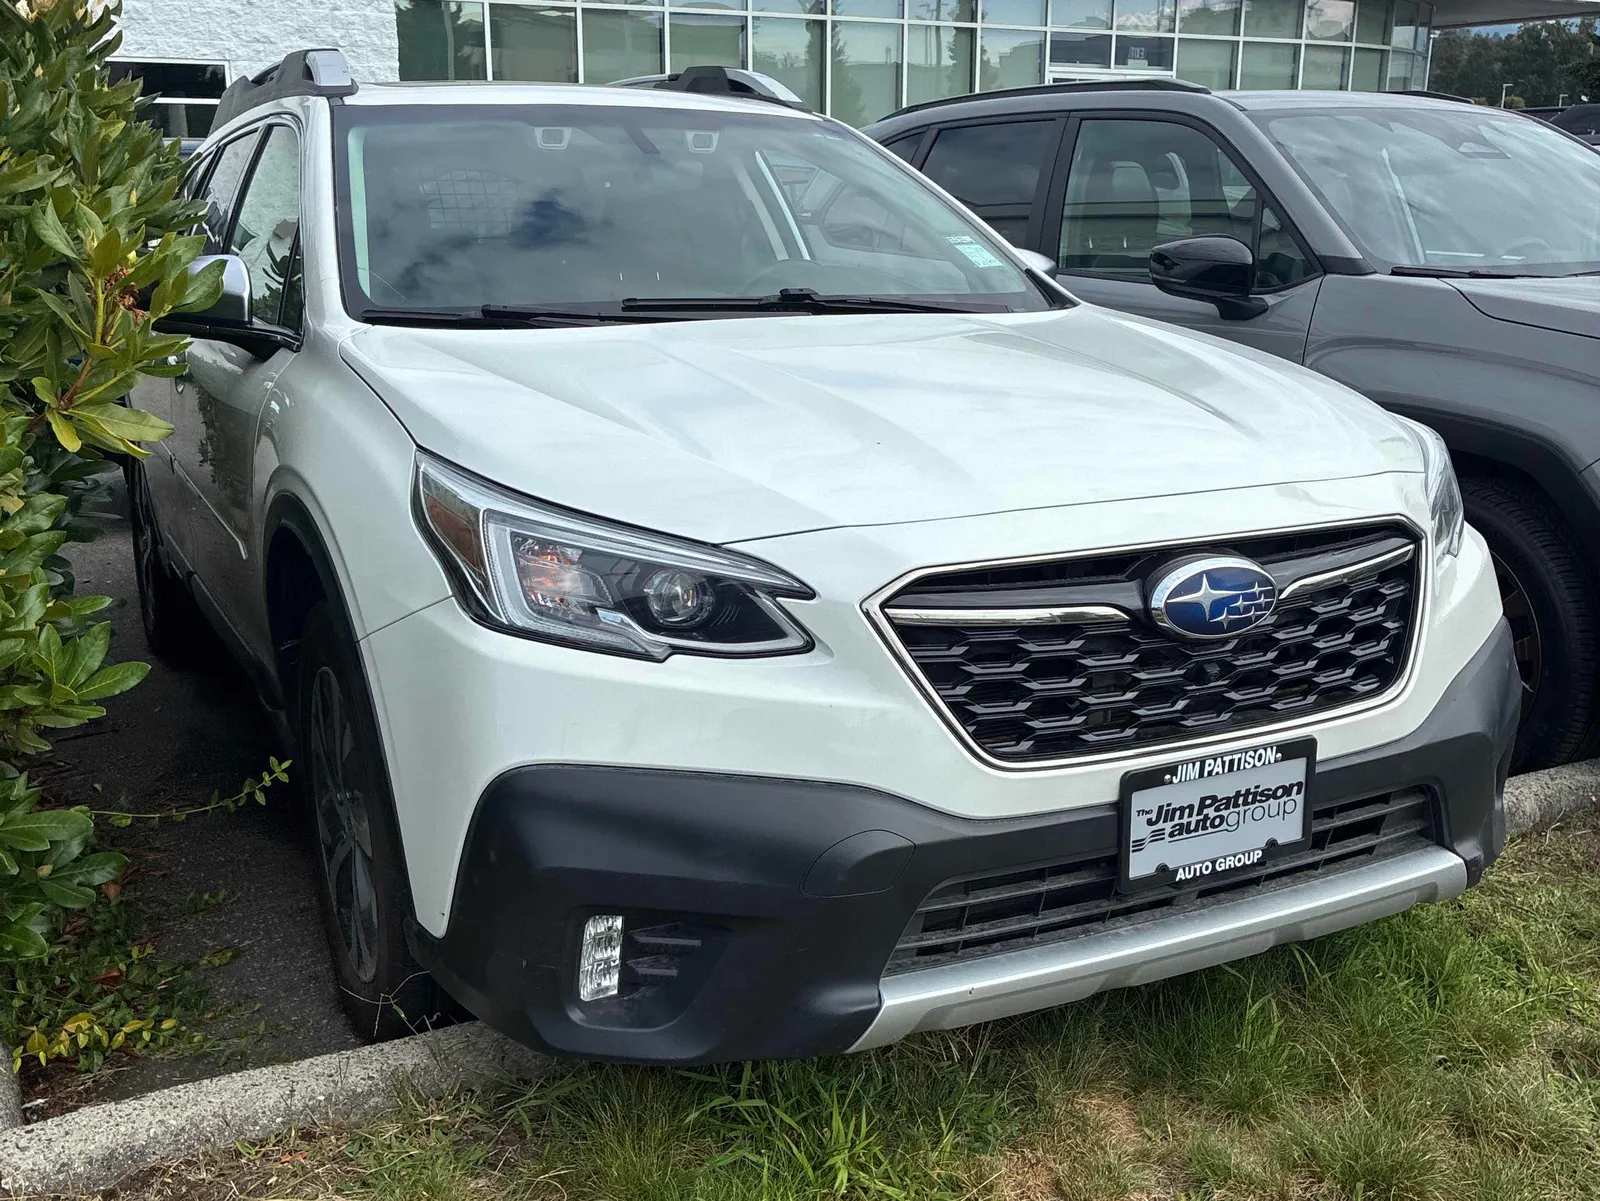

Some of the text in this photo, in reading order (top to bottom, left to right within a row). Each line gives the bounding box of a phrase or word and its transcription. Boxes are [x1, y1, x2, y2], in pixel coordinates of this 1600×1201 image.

[1172, 746, 1277, 784] JIM PATTISON
[1136, 780, 1304, 827] The Jim Pattison
[1175, 849, 1263, 882] AUTO GROUP
